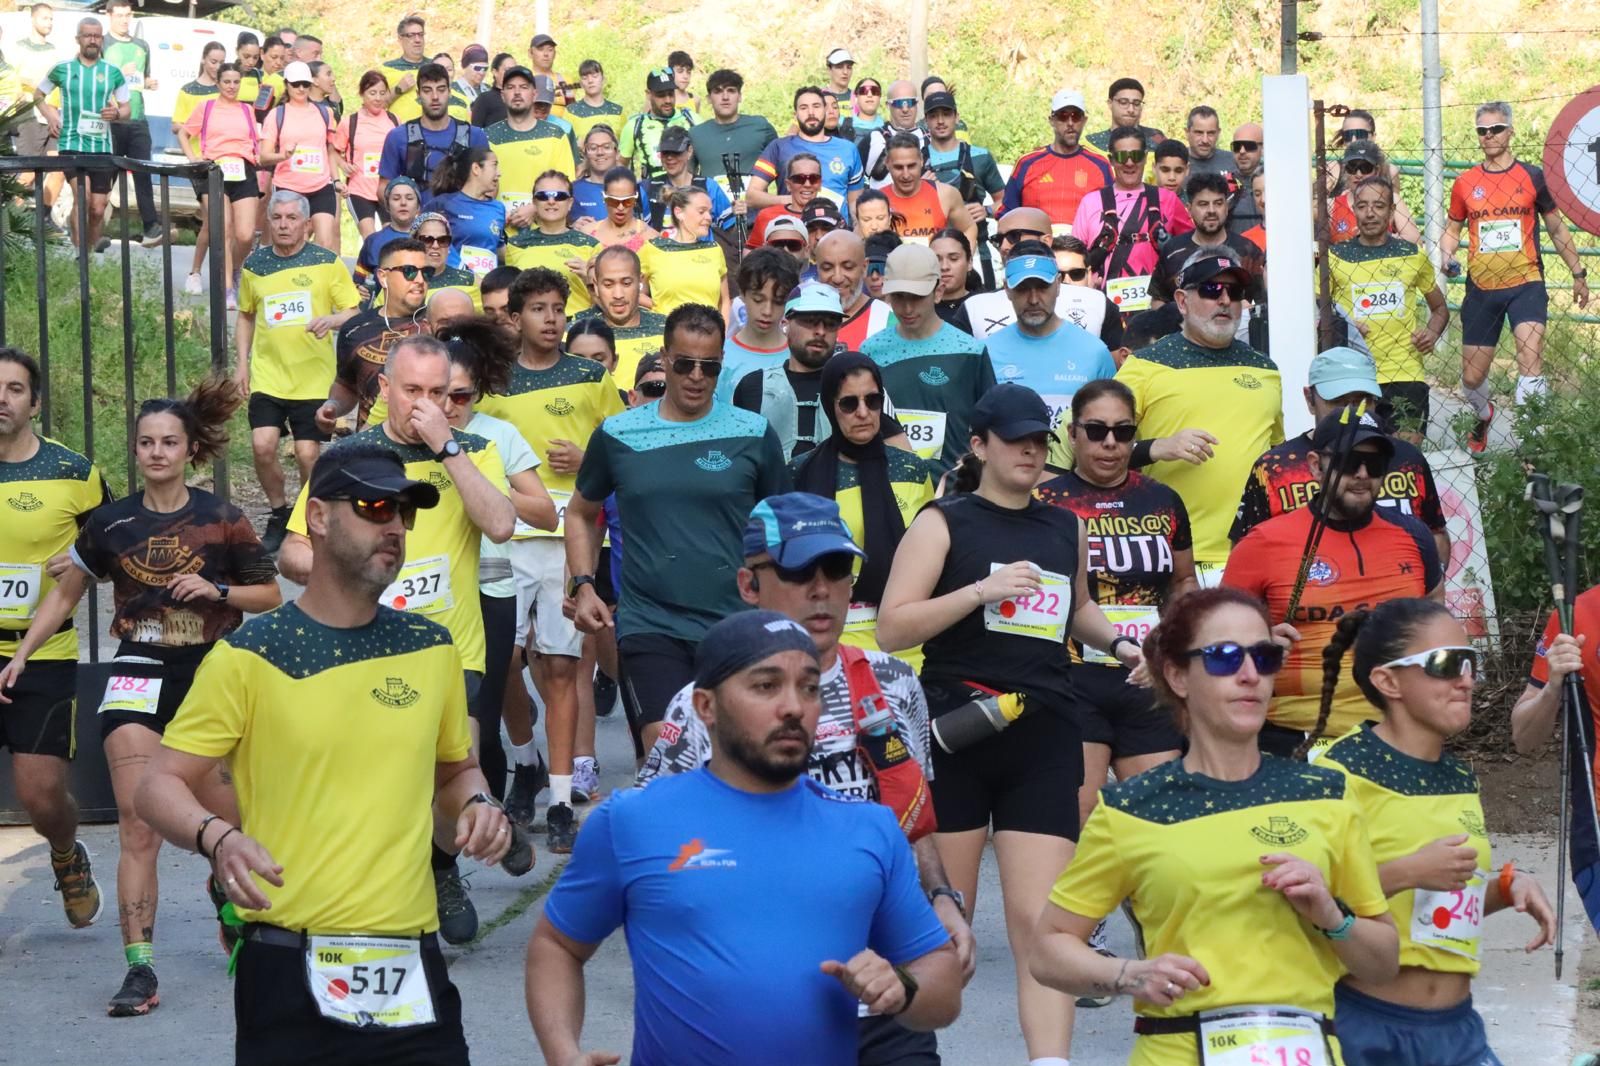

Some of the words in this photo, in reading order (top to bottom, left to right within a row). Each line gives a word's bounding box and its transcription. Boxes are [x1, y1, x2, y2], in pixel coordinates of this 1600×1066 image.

[223, 164, 240, 173] 555
[1496, 232, 1510, 242] 45
[475, 256, 494, 271] 366
[1121, 286, 1147, 300] 533
[1369, 293, 1397, 306] 284
[279, 301, 305, 315] 346
[1086, 514, 1172, 536] AÑOS@S
[1086, 535, 1174, 573] EUTA
[2, 580, 29, 599] 70
[402, 573, 441, 597] 327
[1015, 588, 1060, 616] 422
[112, 677, 149, 692] 282
[1449, 889, 1480, 927] 245
[317, 952, 343, 963] 10K
[350, 965, 407, 996] 517
[1209, 1034, 1237, 1048] 10K
